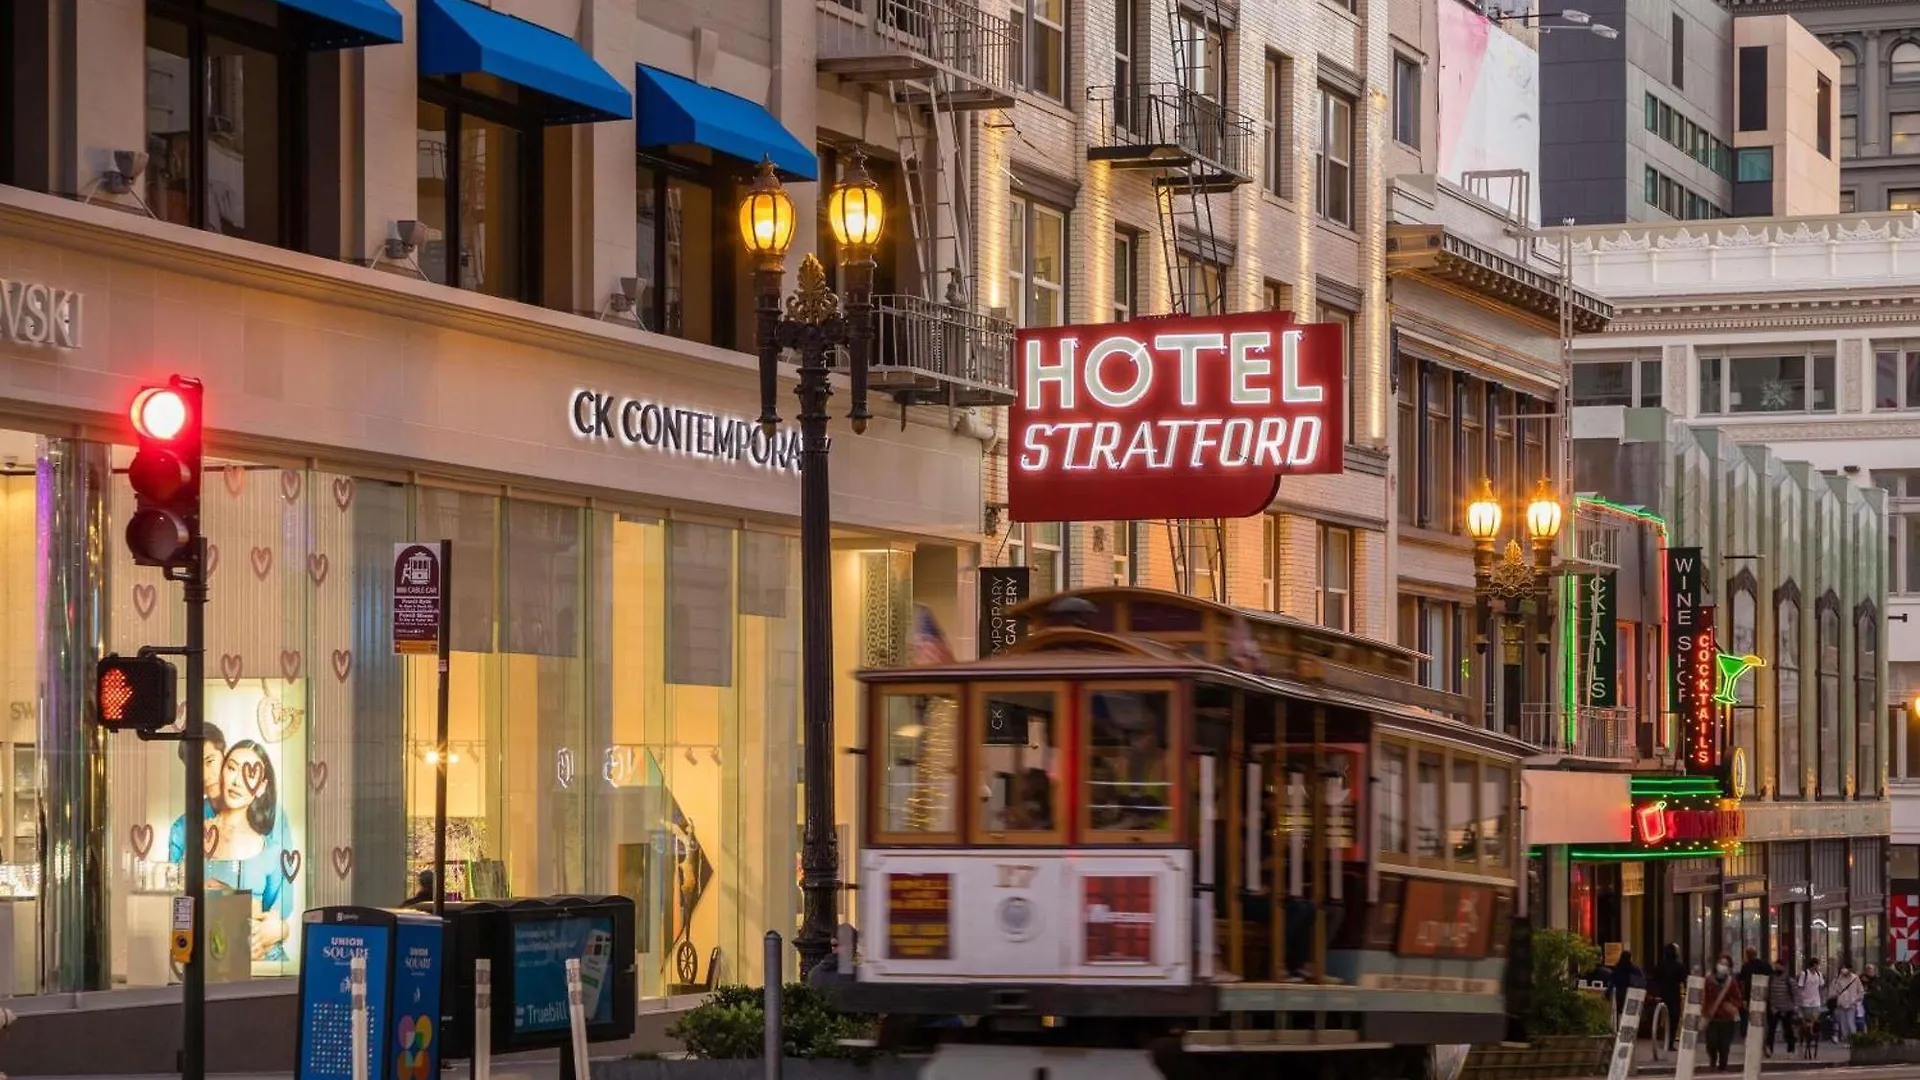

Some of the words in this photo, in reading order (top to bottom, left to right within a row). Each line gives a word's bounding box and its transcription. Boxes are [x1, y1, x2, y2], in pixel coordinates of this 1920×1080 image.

[0, 279, 84, 349] VSKI
[1024, 329, 1324, 411] HOTEL
[573, 390, 615, 439] CK
[621, 399, 831, 472] CONTEMPORA
[1019, 415, 1323, 472] STRATFORD
[1675, 558, 1693, 625] WINE
[1698, 634, 1711, 763] COCKTAILS
[322, 946, 370, 960] SQUARE
[330, 936, 364, 946] UNION
[526, 999, 569, 1025] Truebill
